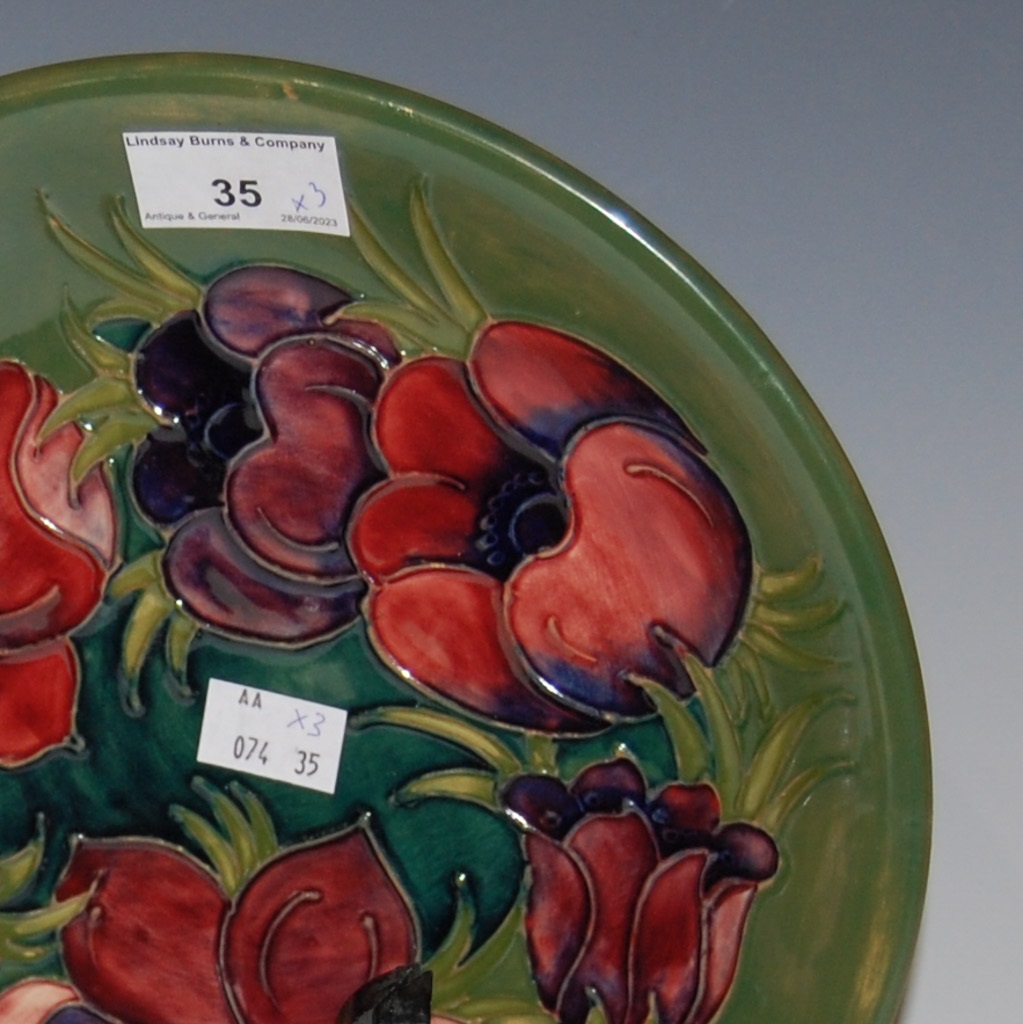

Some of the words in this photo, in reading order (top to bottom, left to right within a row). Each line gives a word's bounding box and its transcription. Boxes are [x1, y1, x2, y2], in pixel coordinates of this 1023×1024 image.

[126, 136, 184, 147] Lindsay
[190, 136, 234, 146] Burns
[240, 137, 250, 146] &
[255, 137, 325, 151] Company
[212, 179, 262, 207] 35
[145, 213, 183, 222] Antique
[198, 213, 240, 221] General
[282, 215, 338, 227] 28/06/2023
[239, 689, 262, 709] AA
[234, 736, 268, 765] 074
[295, 750, 320, 776] 35
